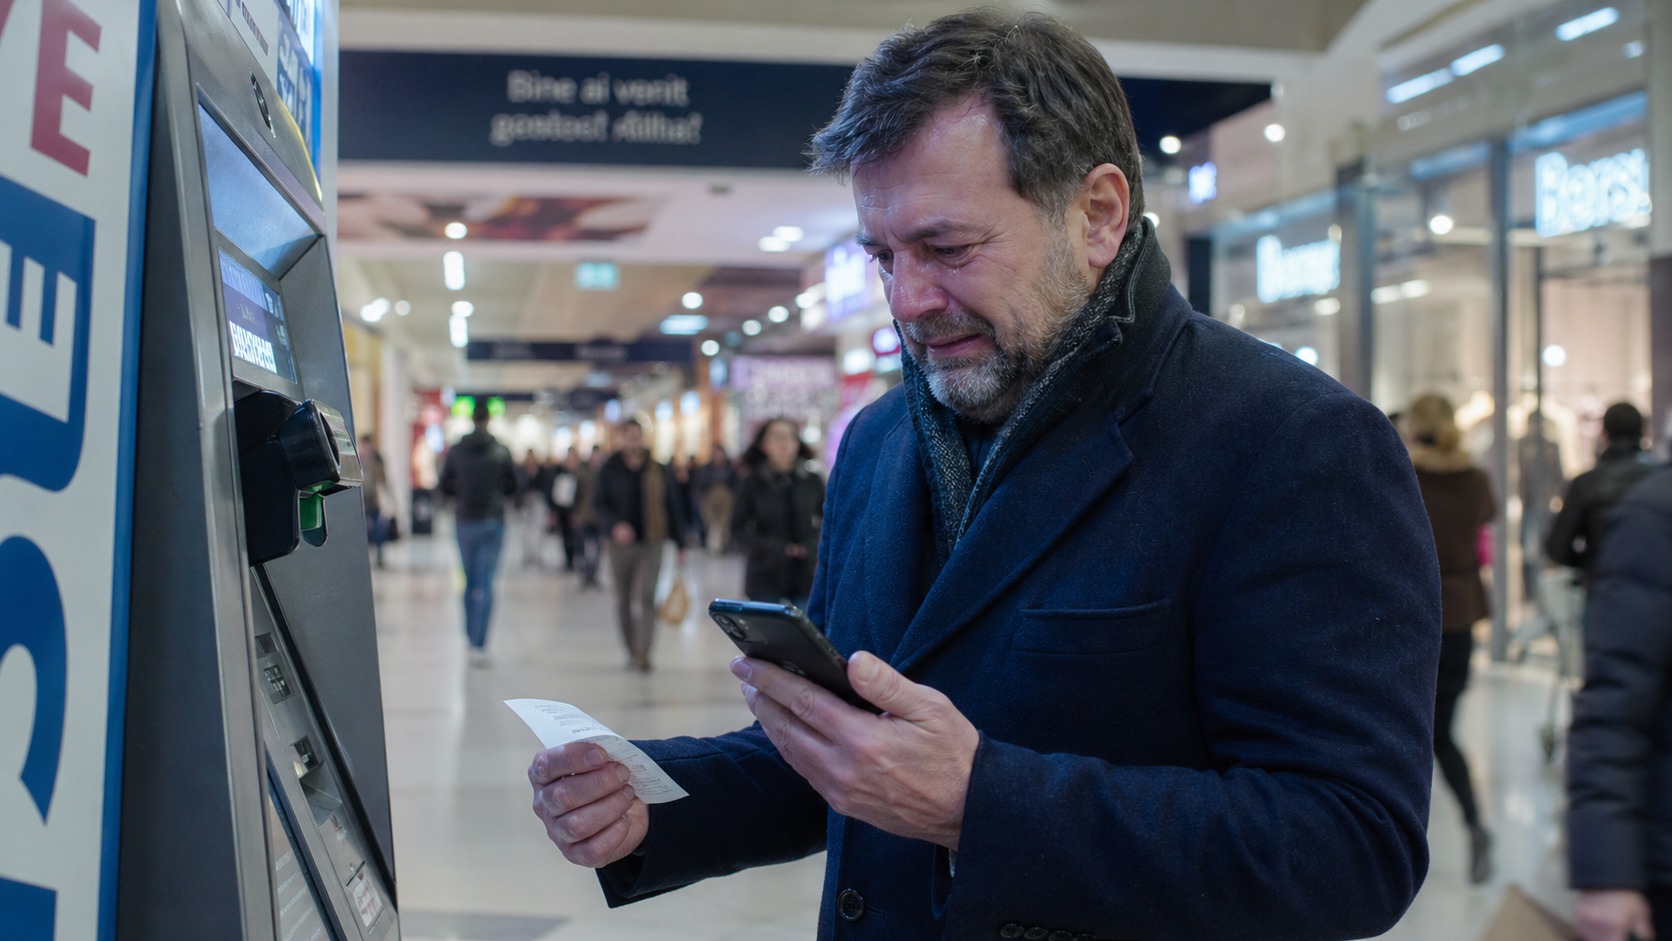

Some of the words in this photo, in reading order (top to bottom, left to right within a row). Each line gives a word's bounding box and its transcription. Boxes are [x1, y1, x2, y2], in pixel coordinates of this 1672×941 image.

[507, 70, 577, 103] Bine
[579, 72, 610, 105] ai
[613, 74, 690, 107] venit
